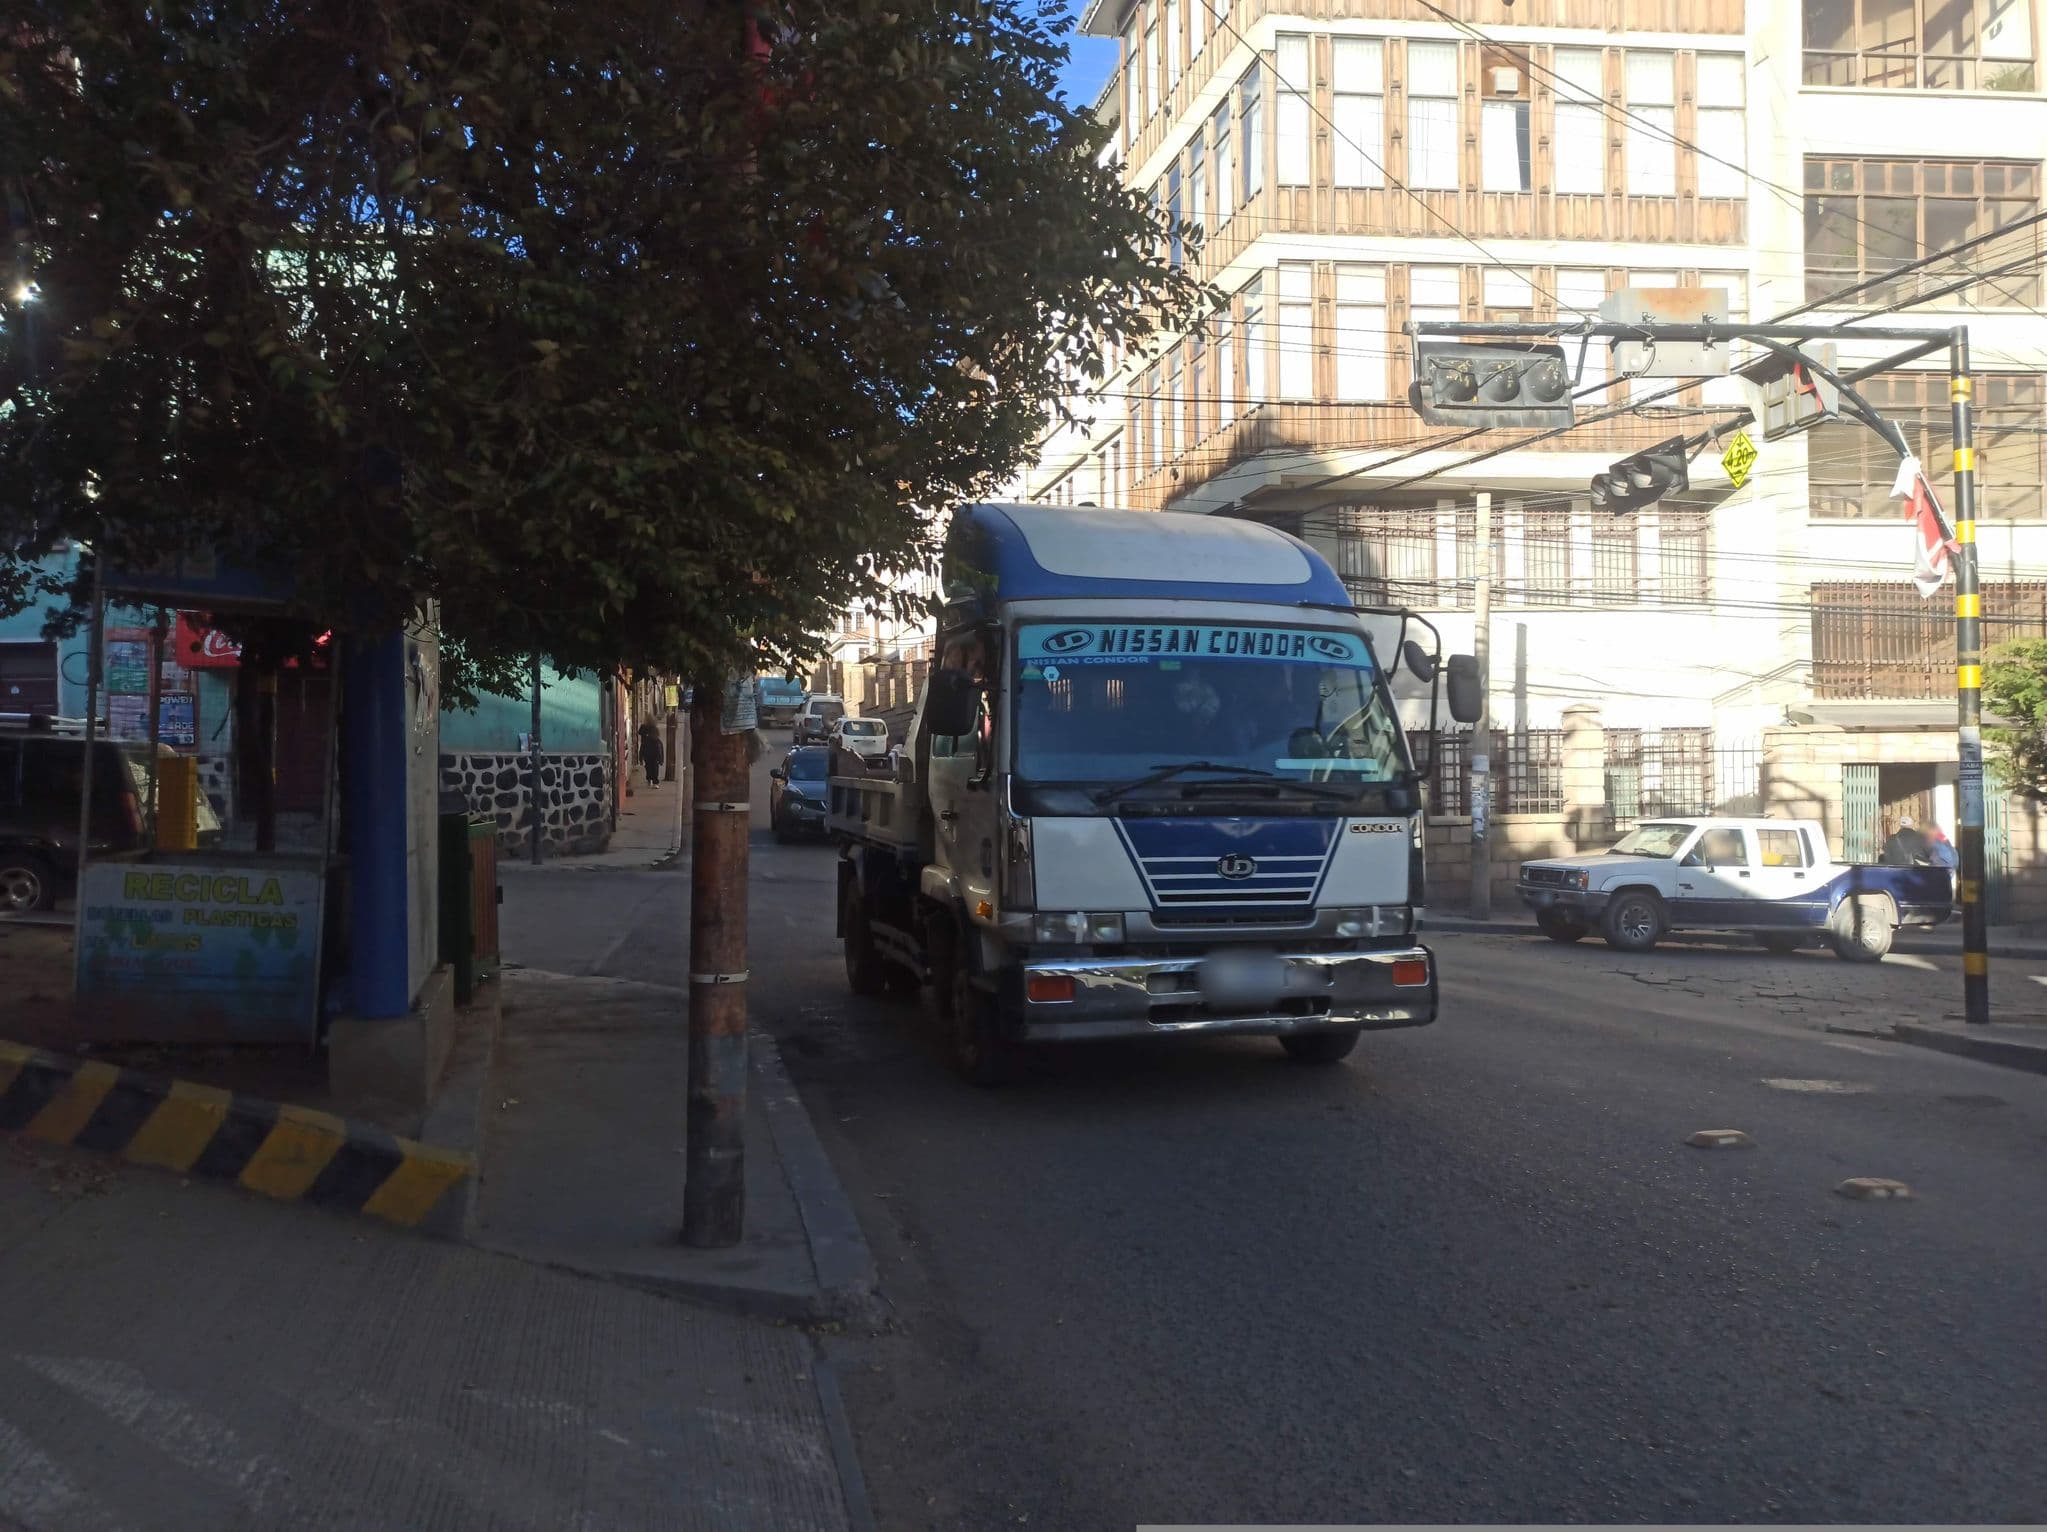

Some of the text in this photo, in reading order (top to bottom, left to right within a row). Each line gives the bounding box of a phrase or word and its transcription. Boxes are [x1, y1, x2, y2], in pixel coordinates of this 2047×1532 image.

[1098, 629, 1200, 653] NISSAN
[1208, 630, 1305, 658] CONDOR
[1028, 656, 1149, 666] NISSAN CONDOR
[1350, 823, 1403, 833] CONDOR
[124, 871, 284, 905] RECICLA
[183, 908, 298, 929] PLASTICAS
